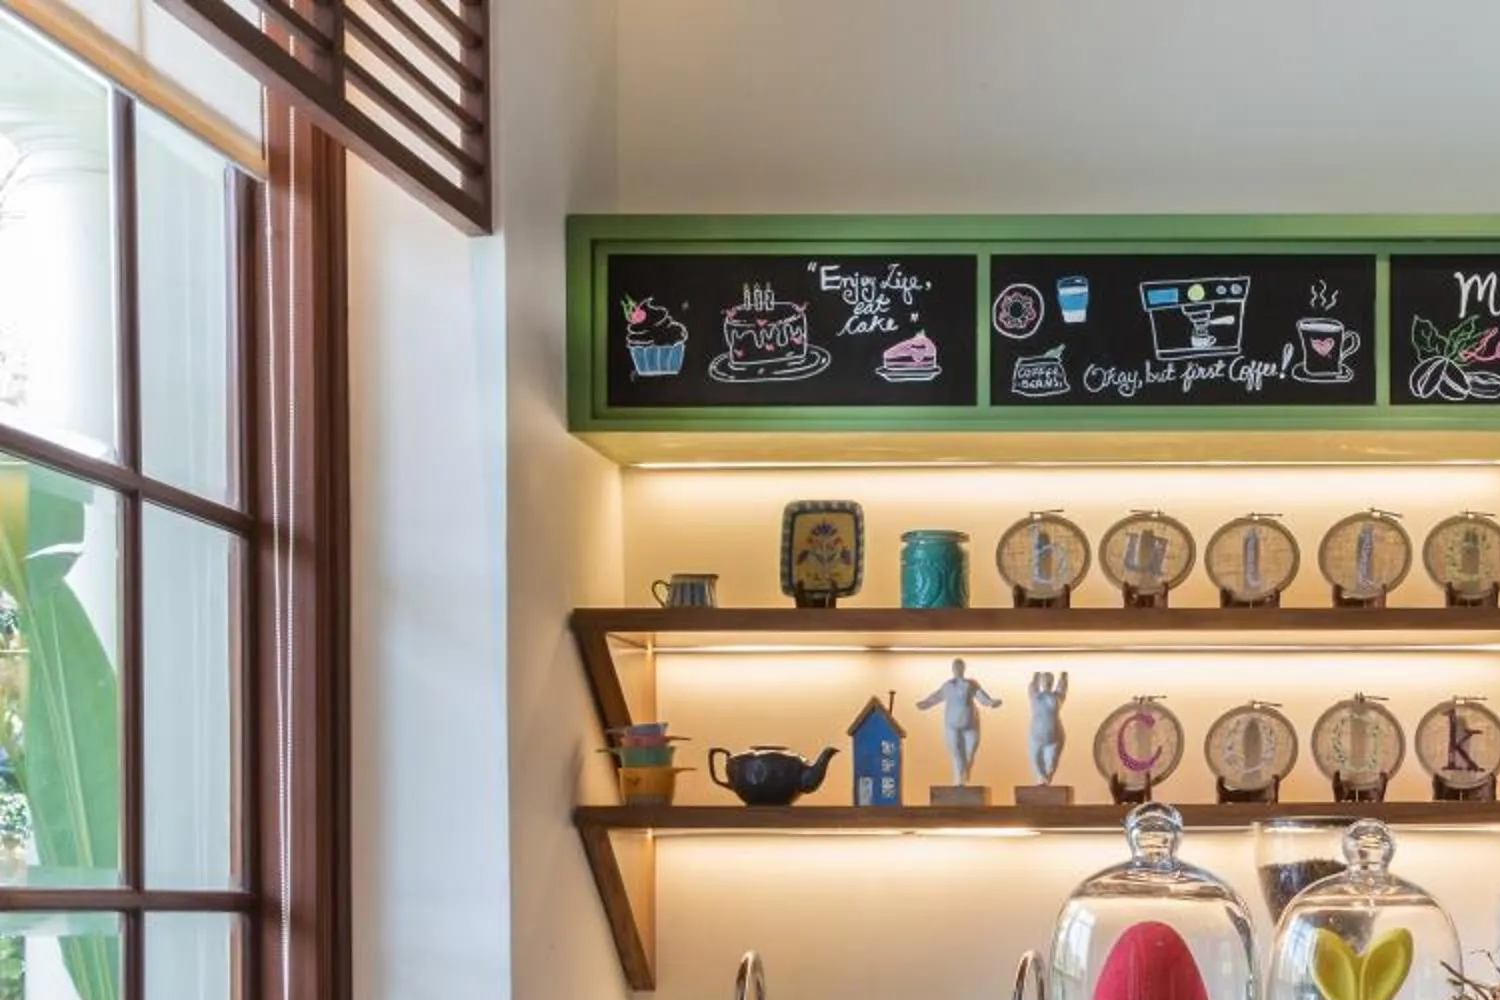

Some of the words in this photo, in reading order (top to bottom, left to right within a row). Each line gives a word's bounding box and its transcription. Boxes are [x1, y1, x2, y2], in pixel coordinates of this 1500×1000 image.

[853, 296, 891, 315] eat
[1144, 360, 1177, 386] but
[1180, 358, 1225, 393] first
